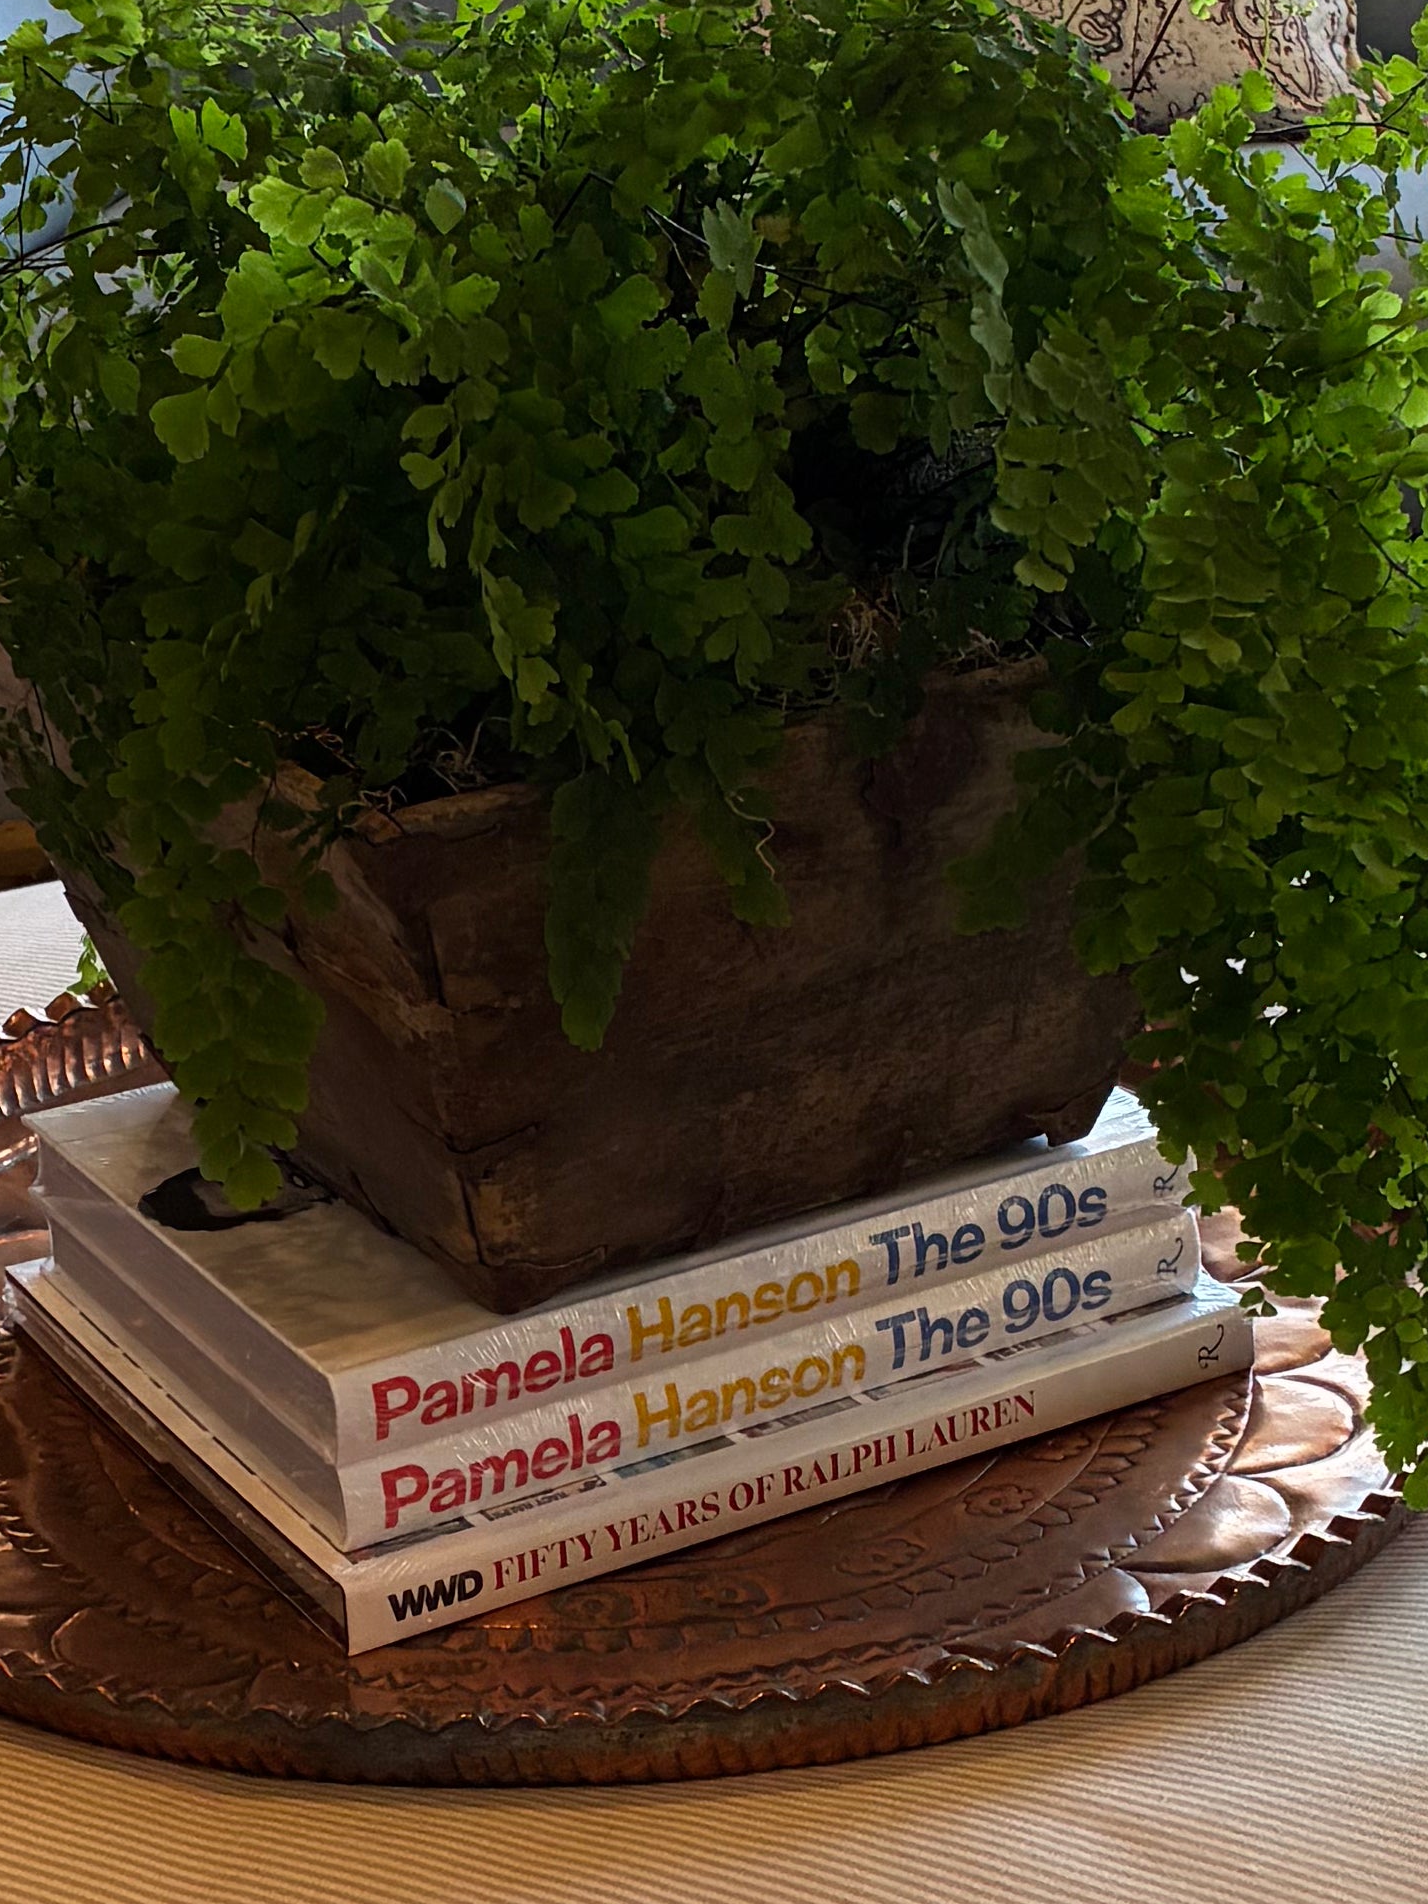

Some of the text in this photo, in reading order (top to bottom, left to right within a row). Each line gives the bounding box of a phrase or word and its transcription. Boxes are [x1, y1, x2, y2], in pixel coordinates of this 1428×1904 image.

[371, 1183, 1108, 1442] Pamela Hanson The 90s
[380, 1266, 1113, 1530] Pamela Hanson The 90s
[387, 1569, 484, 1622] WWD
[493, 1529, 598, 1592] FIFTY
[603, 1490, 721, 1553] YEARS
[728, 1471, 776, 1513] OF
[782, 1433, 897, 1498] RALPH
[904, 1390, 1037, 1457] LAUREN
